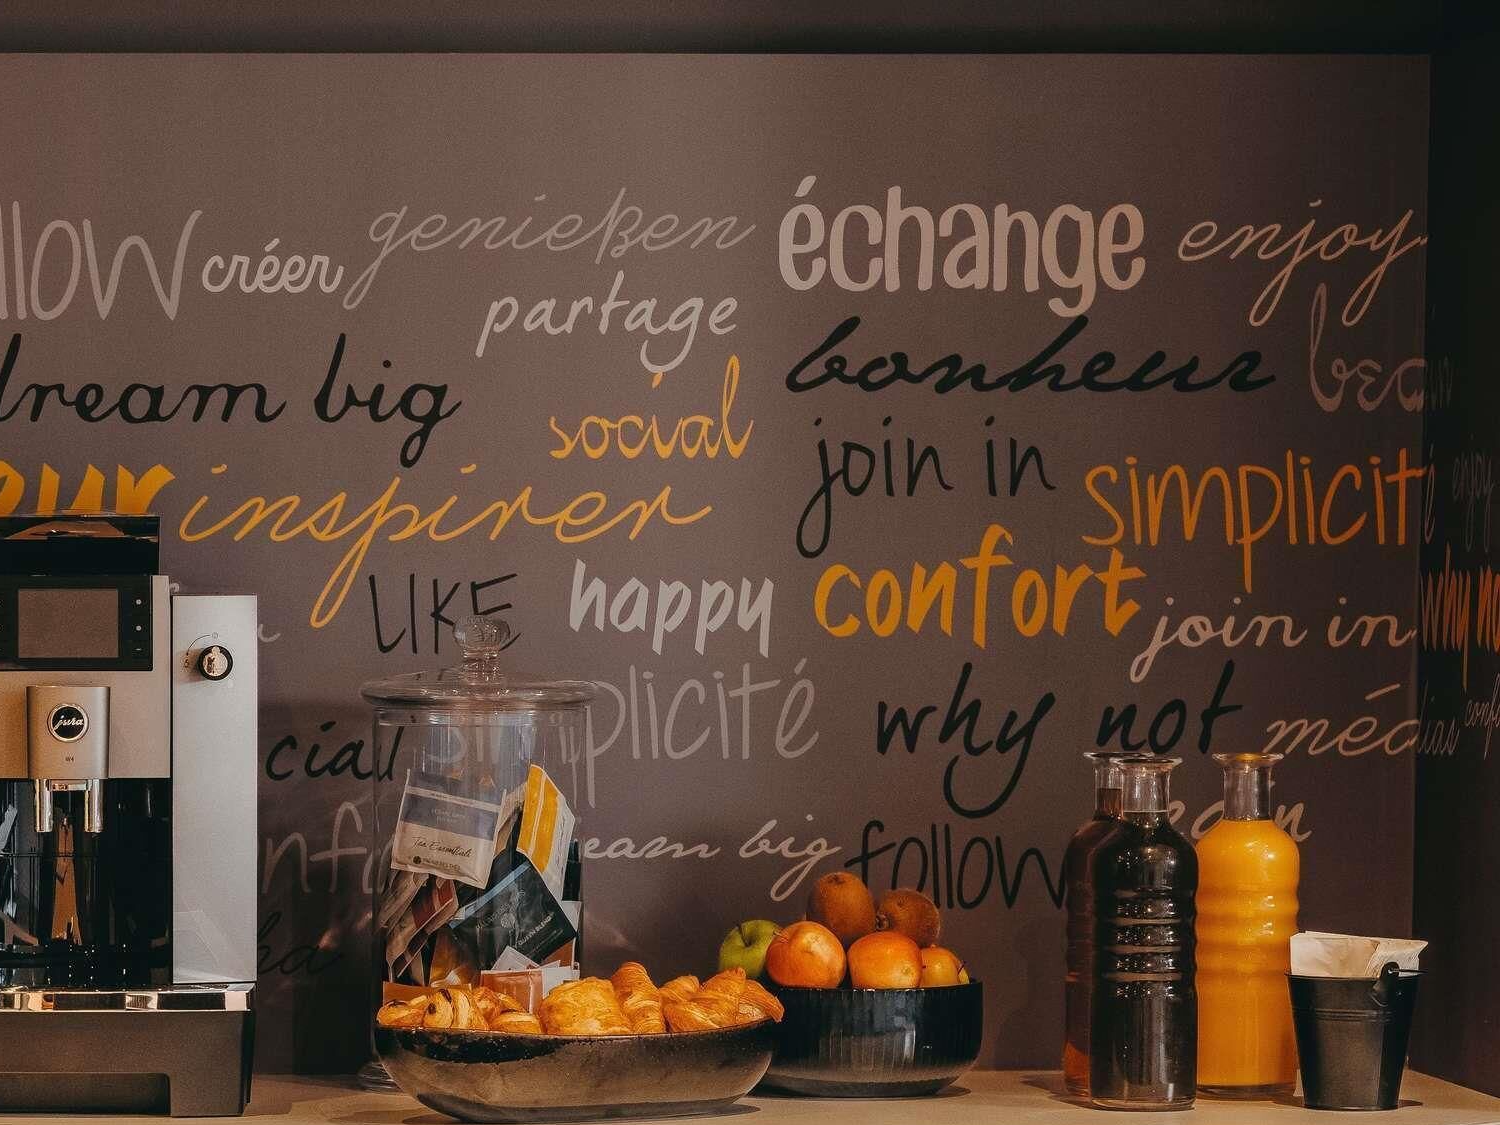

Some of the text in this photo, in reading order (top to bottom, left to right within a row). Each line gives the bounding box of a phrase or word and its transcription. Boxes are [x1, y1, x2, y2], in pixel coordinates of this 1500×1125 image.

[200, 238, 345, 295] créer
[778, 174, 1147, 318] échange
[1177, 199, 1429, 327] enjoy
[475, 270, 739, 375] partage
[785, 315, 1277, 395] bonheur
[314, 332, 462, 468] big
[550, 354, 755, 461] social
[795, 415, 1057, 559] join in
[178, 463, 712, 628] inspirer
[814, 524, 1148, 649] confort
[369, 573, 521, 656] LIKE
[567, 559, 775, 657] happy
[1130, 596, 1417, 683] join in
[53, 715, 84, 731] jura
[877, 659, 1243, 819] why not
[739, 811, 843, 900] big
